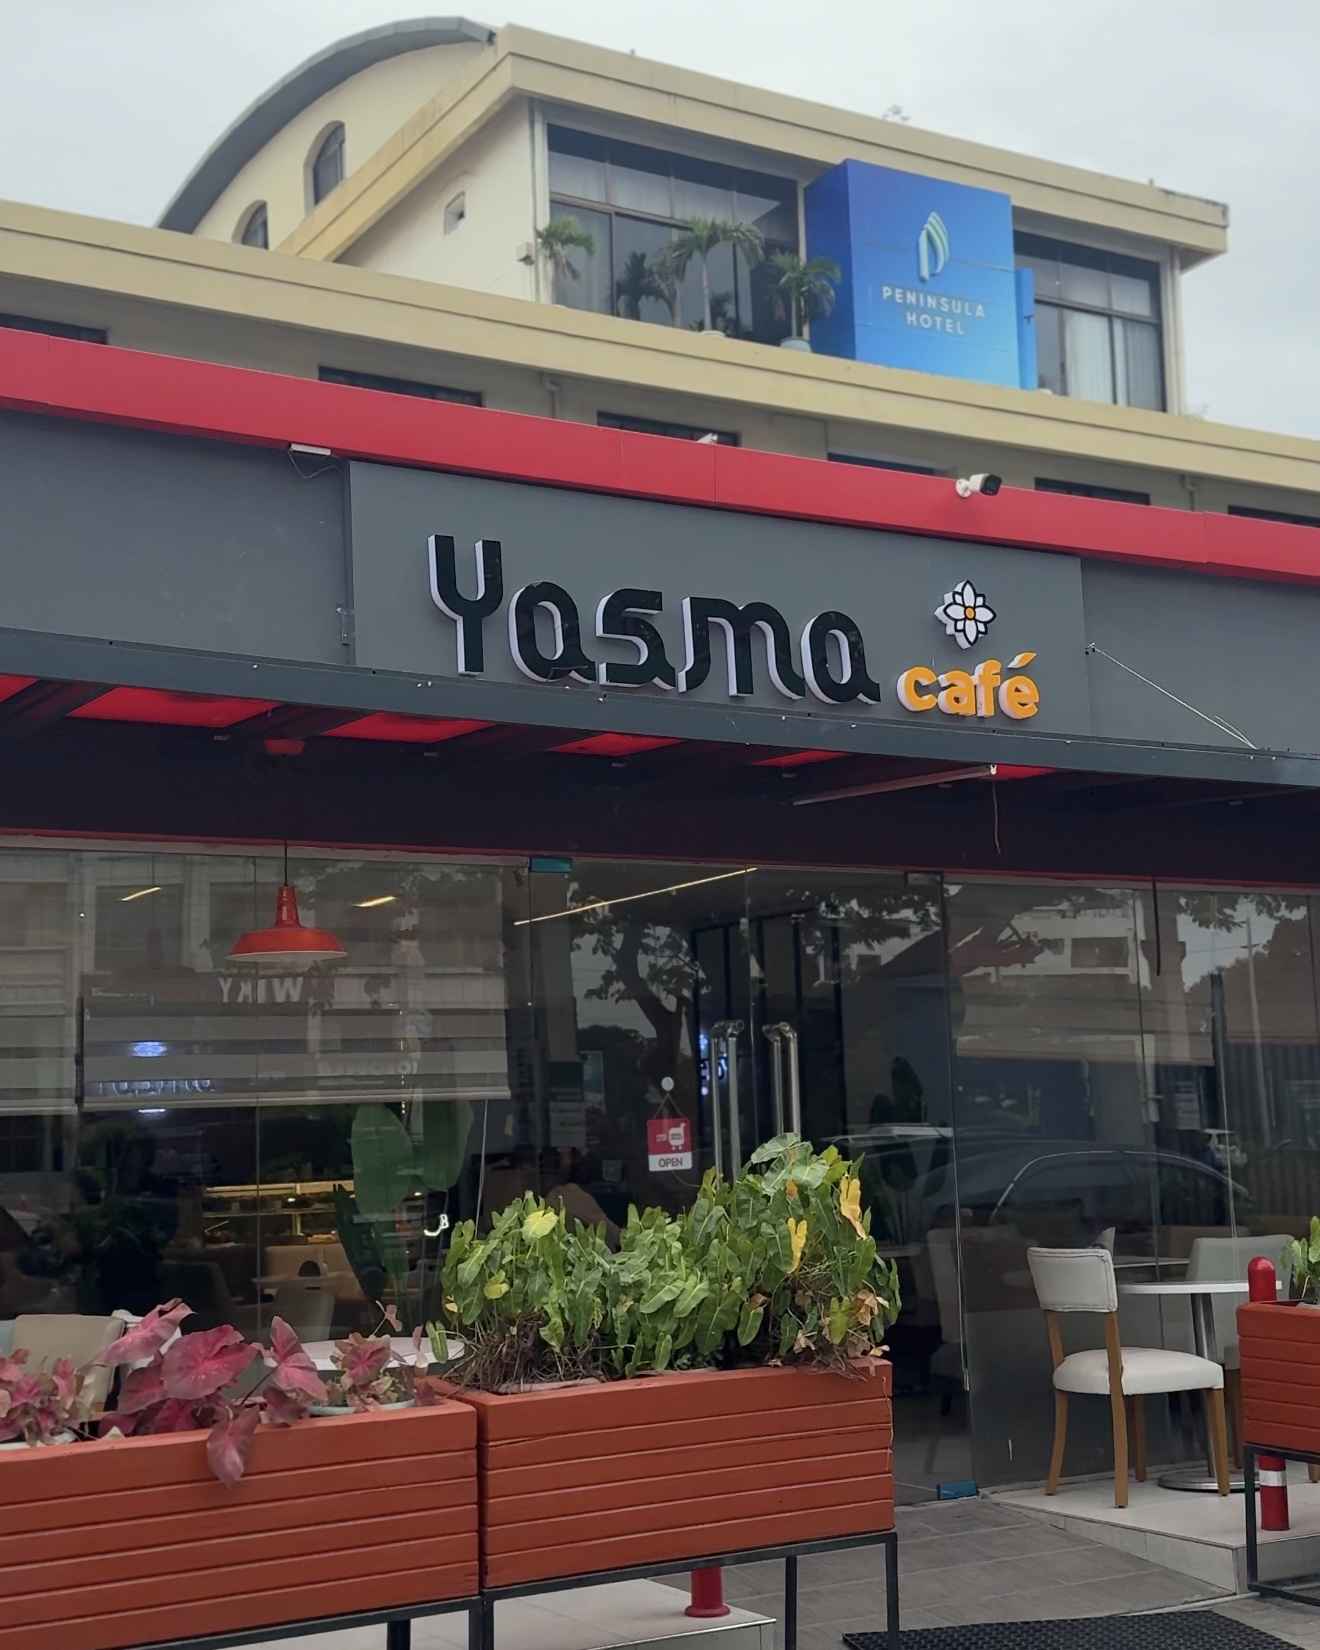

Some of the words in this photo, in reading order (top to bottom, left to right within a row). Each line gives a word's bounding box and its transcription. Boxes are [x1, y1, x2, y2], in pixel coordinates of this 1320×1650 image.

[882, 285, 986, 319] PENINSULA
[906, 311, 965, 335] HOTEL
[427, 534, 881, 704] Yasma
[896, 651, 1040, 720] café
[658, 1157, 683, 1168] OPEN
